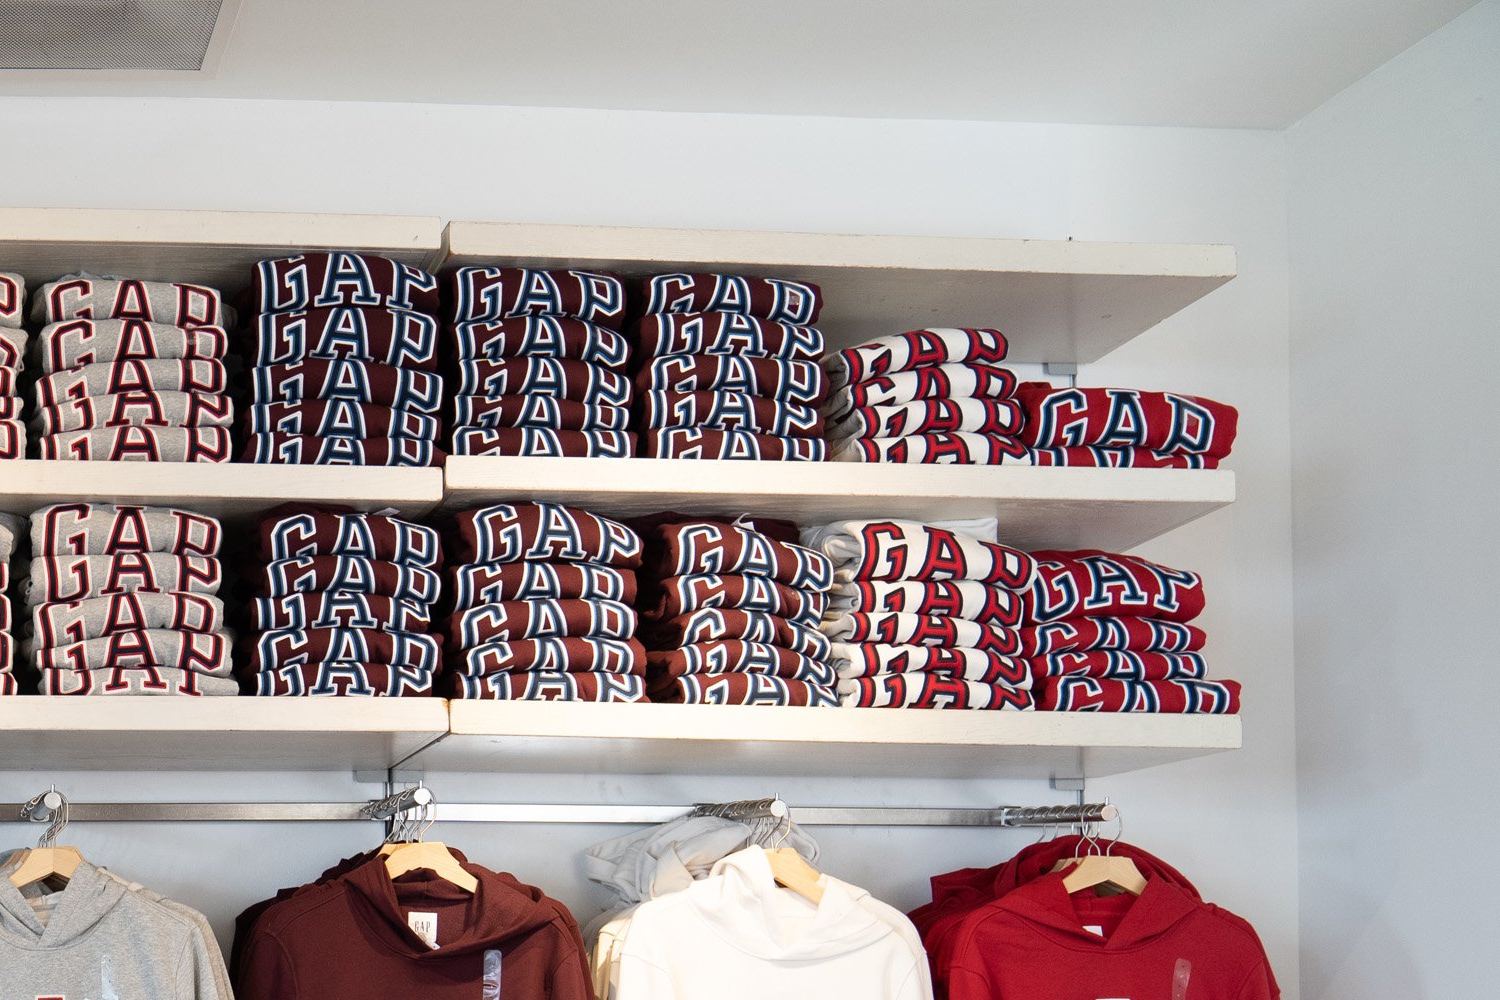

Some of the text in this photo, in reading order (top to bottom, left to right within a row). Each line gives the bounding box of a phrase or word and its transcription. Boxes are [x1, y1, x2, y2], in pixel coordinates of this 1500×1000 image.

[455, 268, 624, 323] GAP
[258, 307, 439, 366] GAP
[656, 312, 824, 359] GAP
[1035, 388, 1215, 455] GAP
[44, 503, 220, 557] GAP
[270, 514, 440, 566] GAP
[473, 501, 640, 564] GAP
[675, 523, 833, 593] GAP
[854, 522, 1038, 592] GAP
[415, 920, 431, 933] GAP
